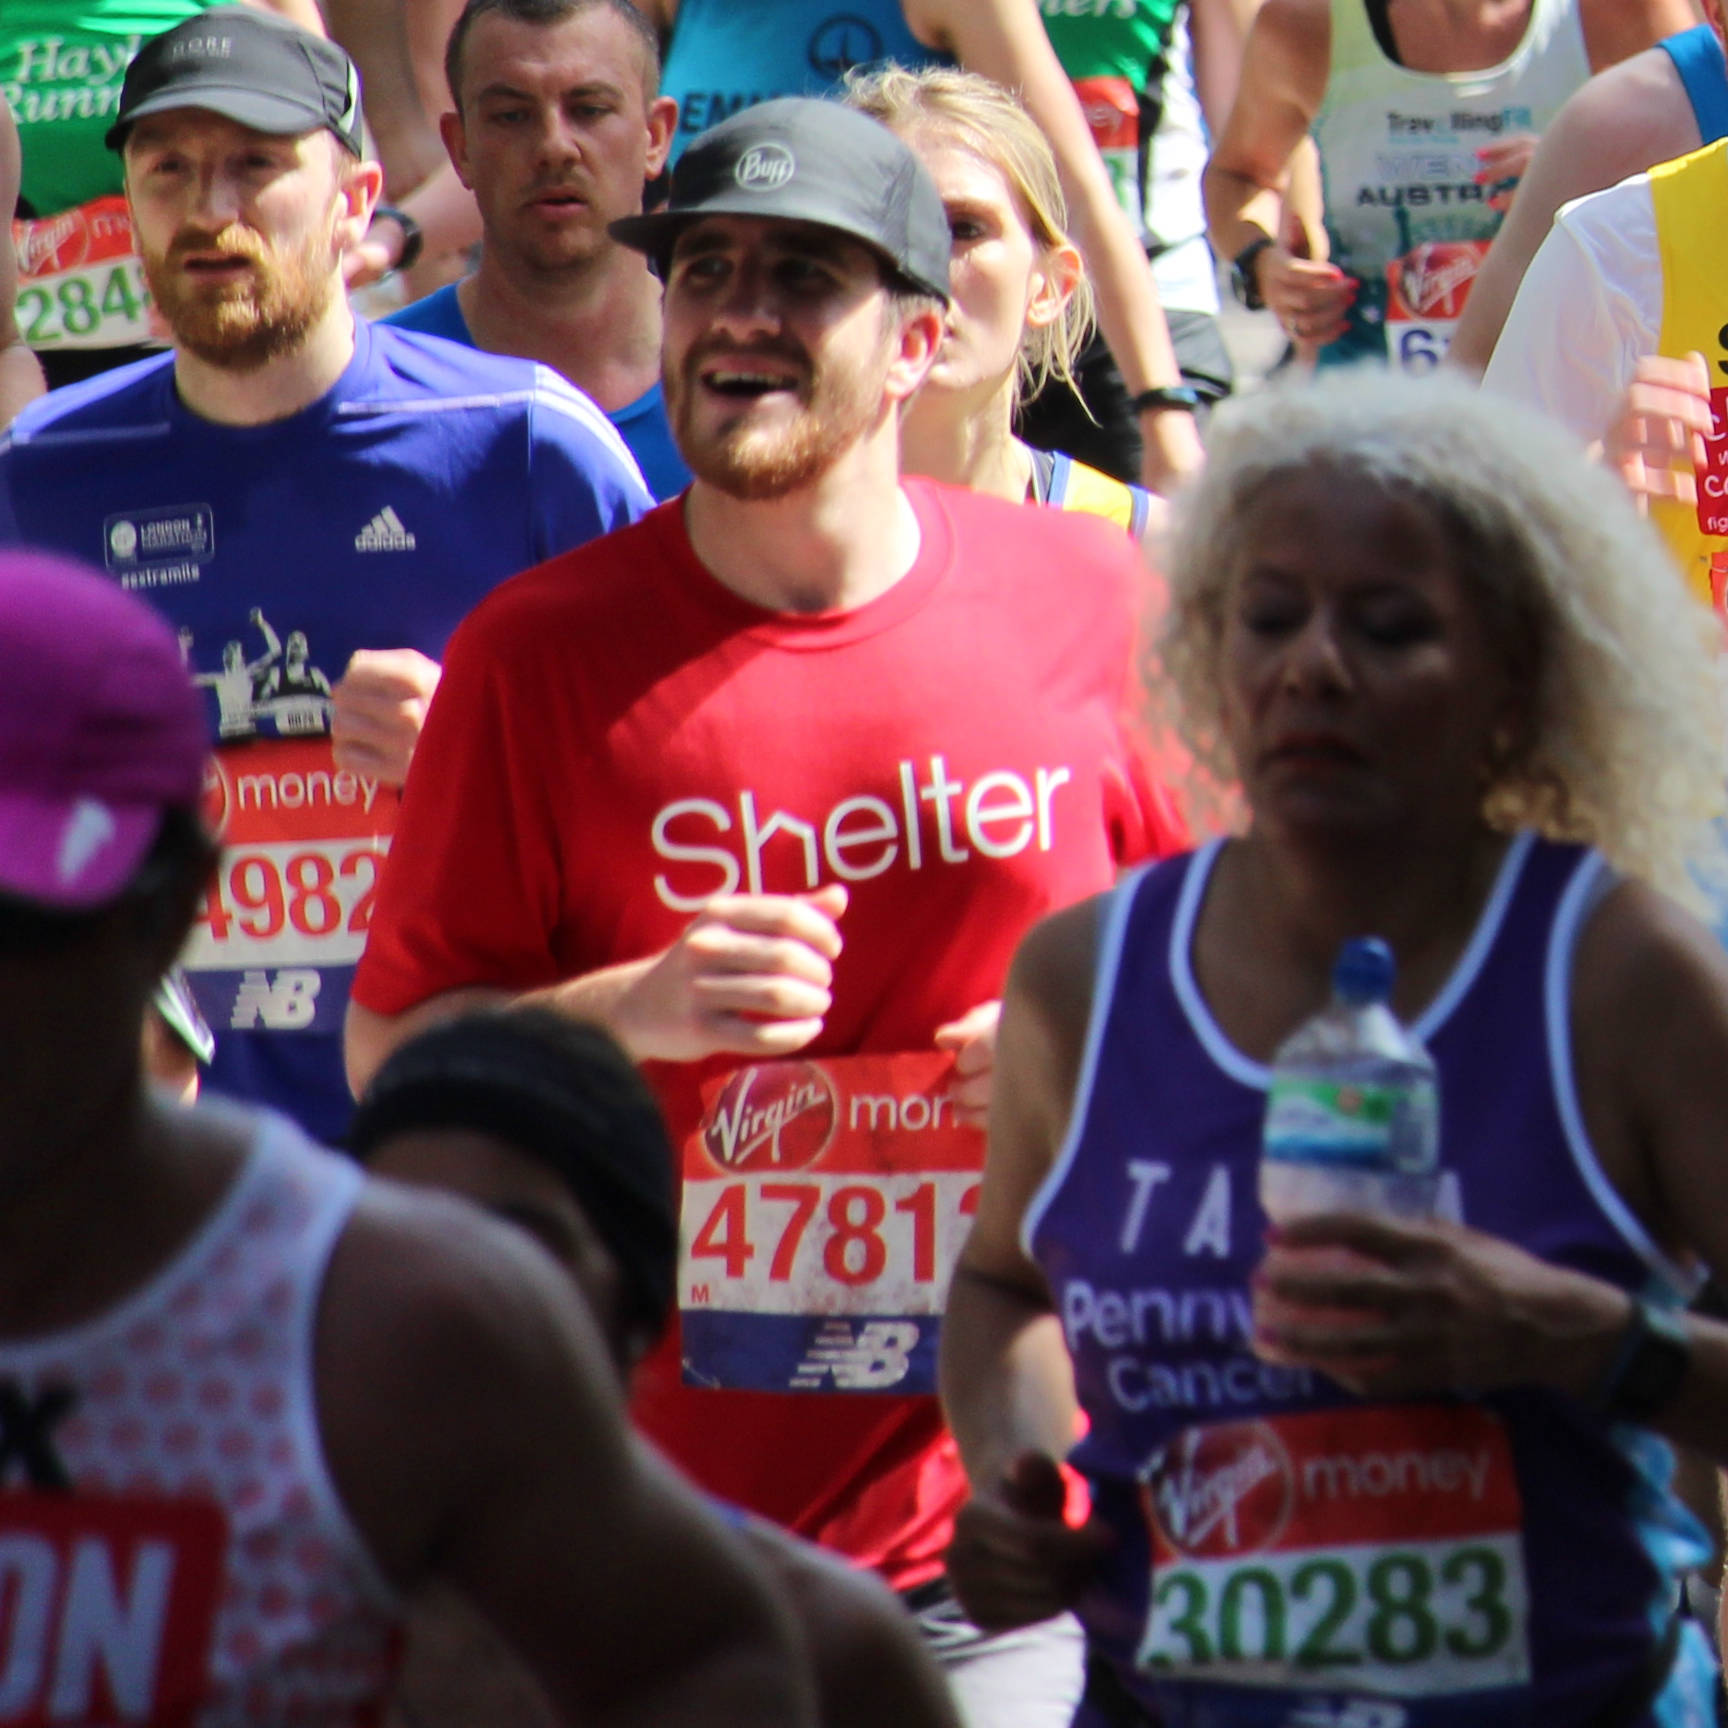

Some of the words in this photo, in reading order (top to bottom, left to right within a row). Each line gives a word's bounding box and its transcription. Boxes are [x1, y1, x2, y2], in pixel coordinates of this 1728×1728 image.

[743, 150, 789, 182] Buff
[17, 265, 149, 344] 284
[355, 532, 416, 552] adidas
[237, 771, 379, 814] money
[651, 762, 1068, 913] Shelter
[710, 1068, 827, 1164] Virgin
[691, 1284, 709, 1303] M
[1303, 1450, 1492, 1502] money
[1149, 1546, 1513, 1668] 30283
